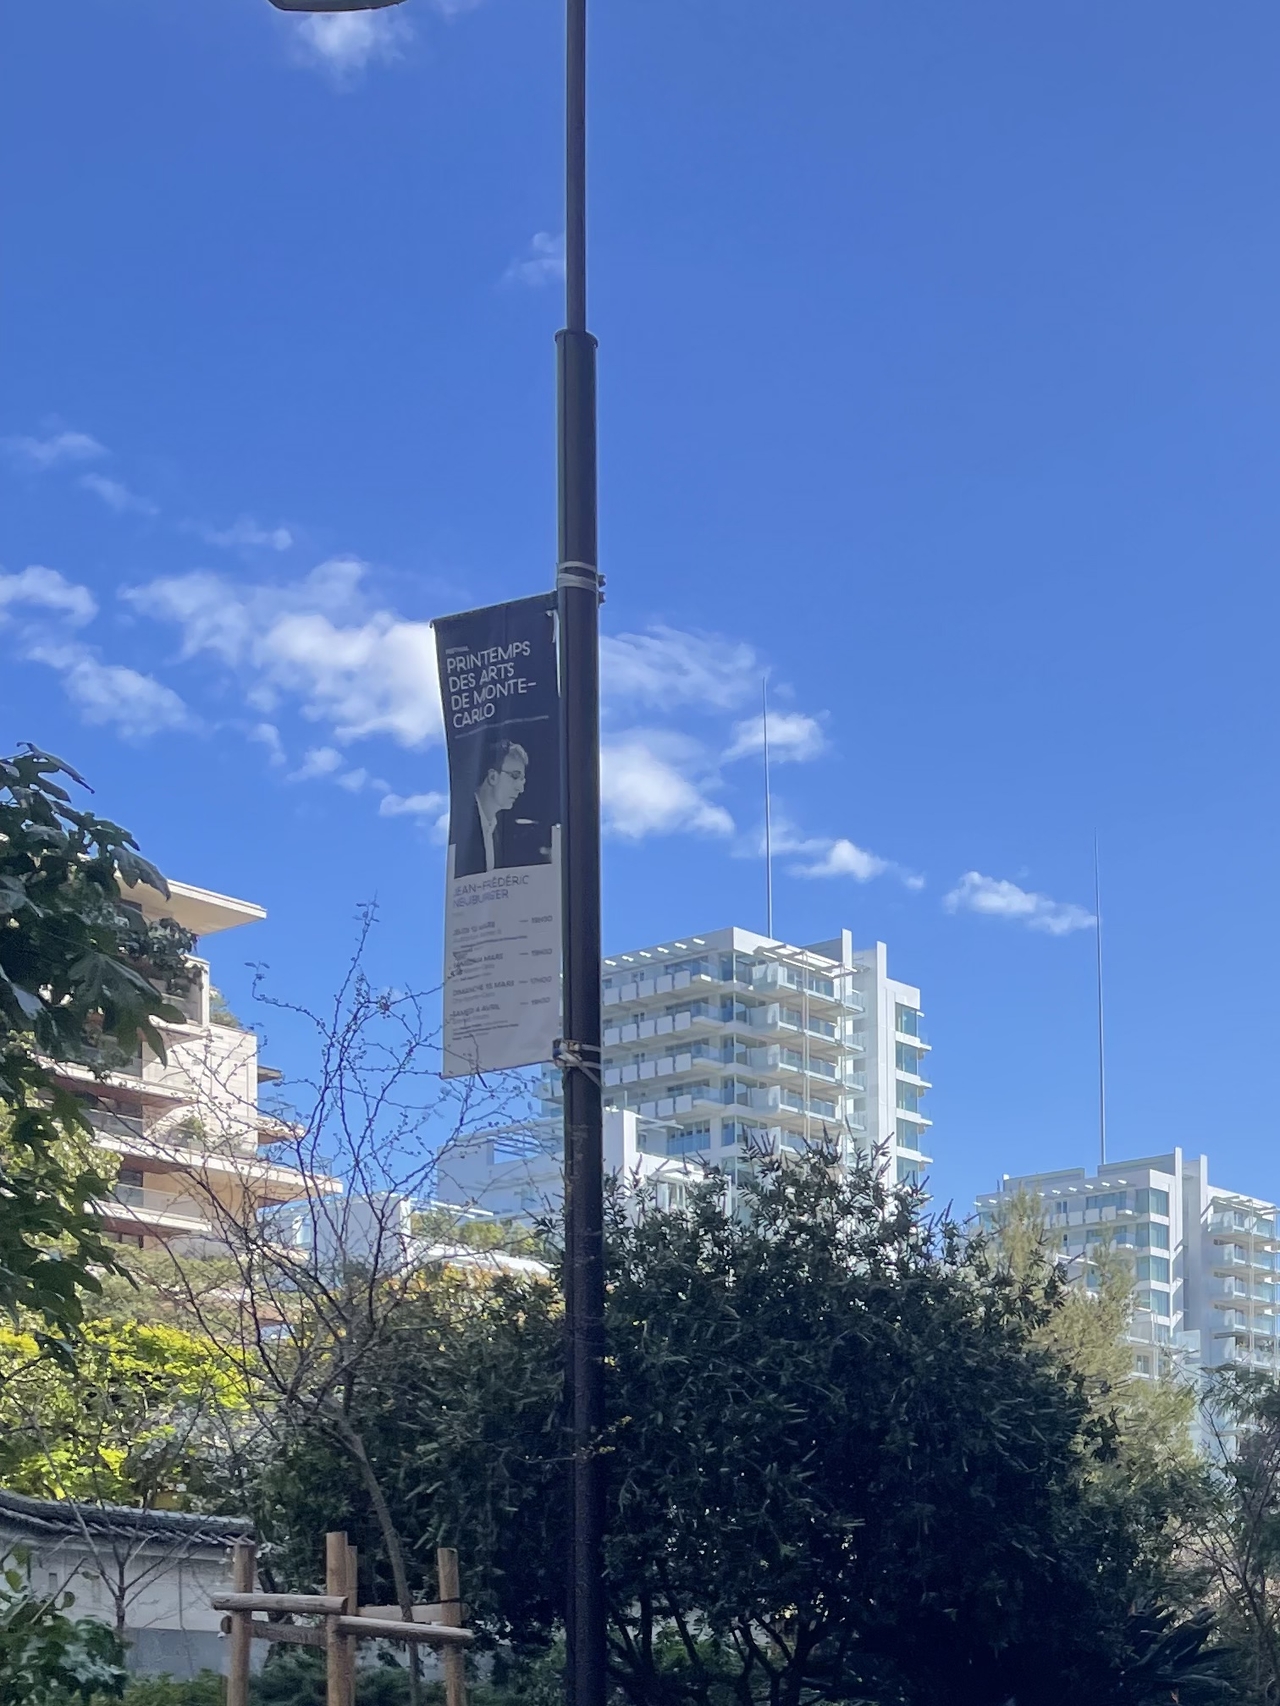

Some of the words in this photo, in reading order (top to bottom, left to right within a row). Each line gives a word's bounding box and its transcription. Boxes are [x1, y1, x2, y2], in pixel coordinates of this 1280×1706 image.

[446, 641, 531, 674] PRINTEMPS
[448, 673, 476, 692] DES
[479, 662, 515, 685] ARTS
[451, 692, 470, 711] DE
[473, 677, 537, 706] MONTE-
[453, 703, 495, 729] CARLO
